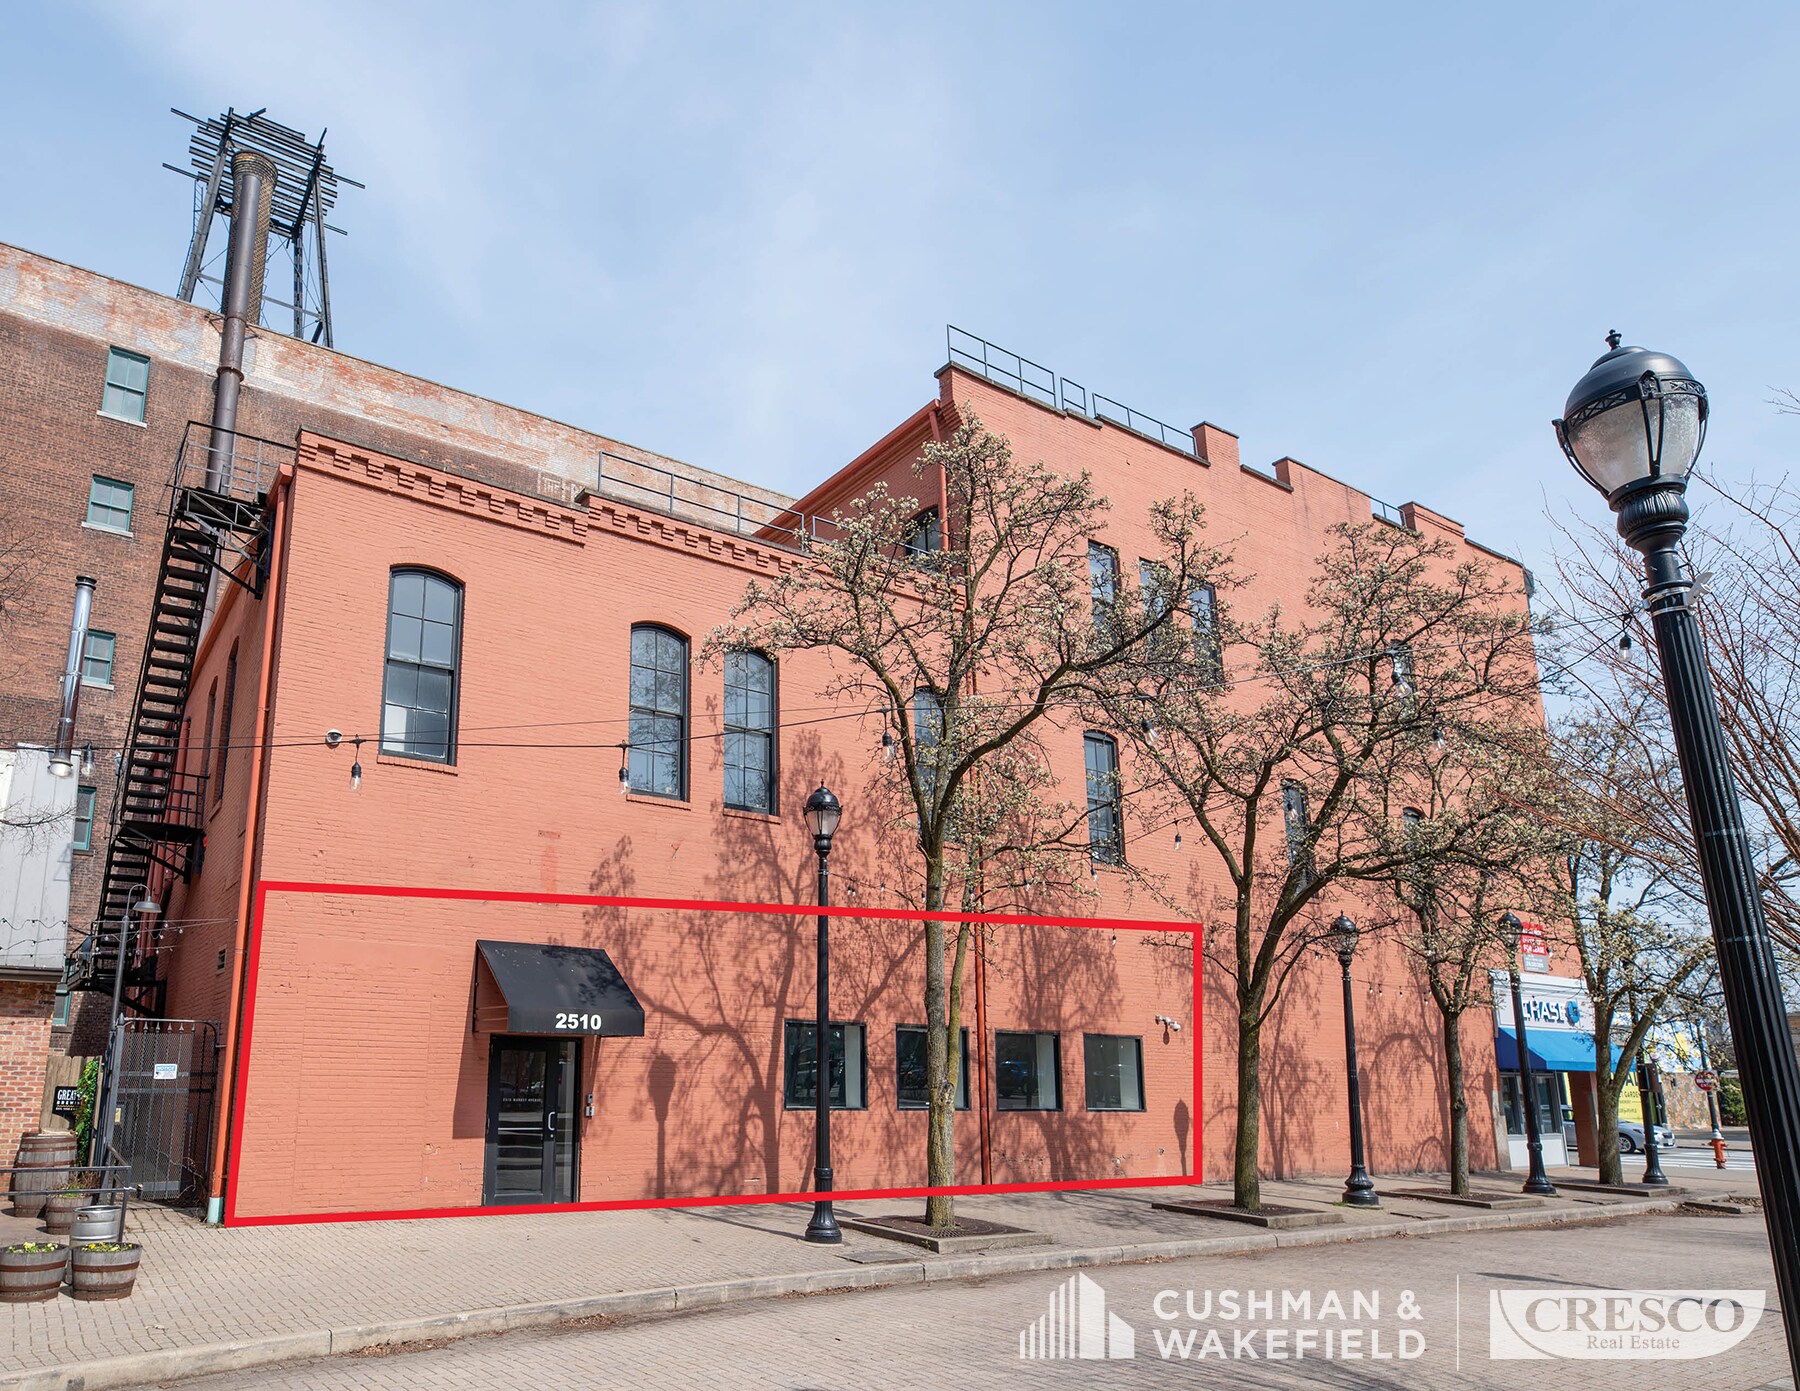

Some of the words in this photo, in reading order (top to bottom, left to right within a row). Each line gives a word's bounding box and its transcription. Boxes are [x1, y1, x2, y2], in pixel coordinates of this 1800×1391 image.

[1522, 1000, 1566, 1022] CHASE
[555, 1012, 602, 1030] 2510
[57, 1089, 77, 1100] GREAT
